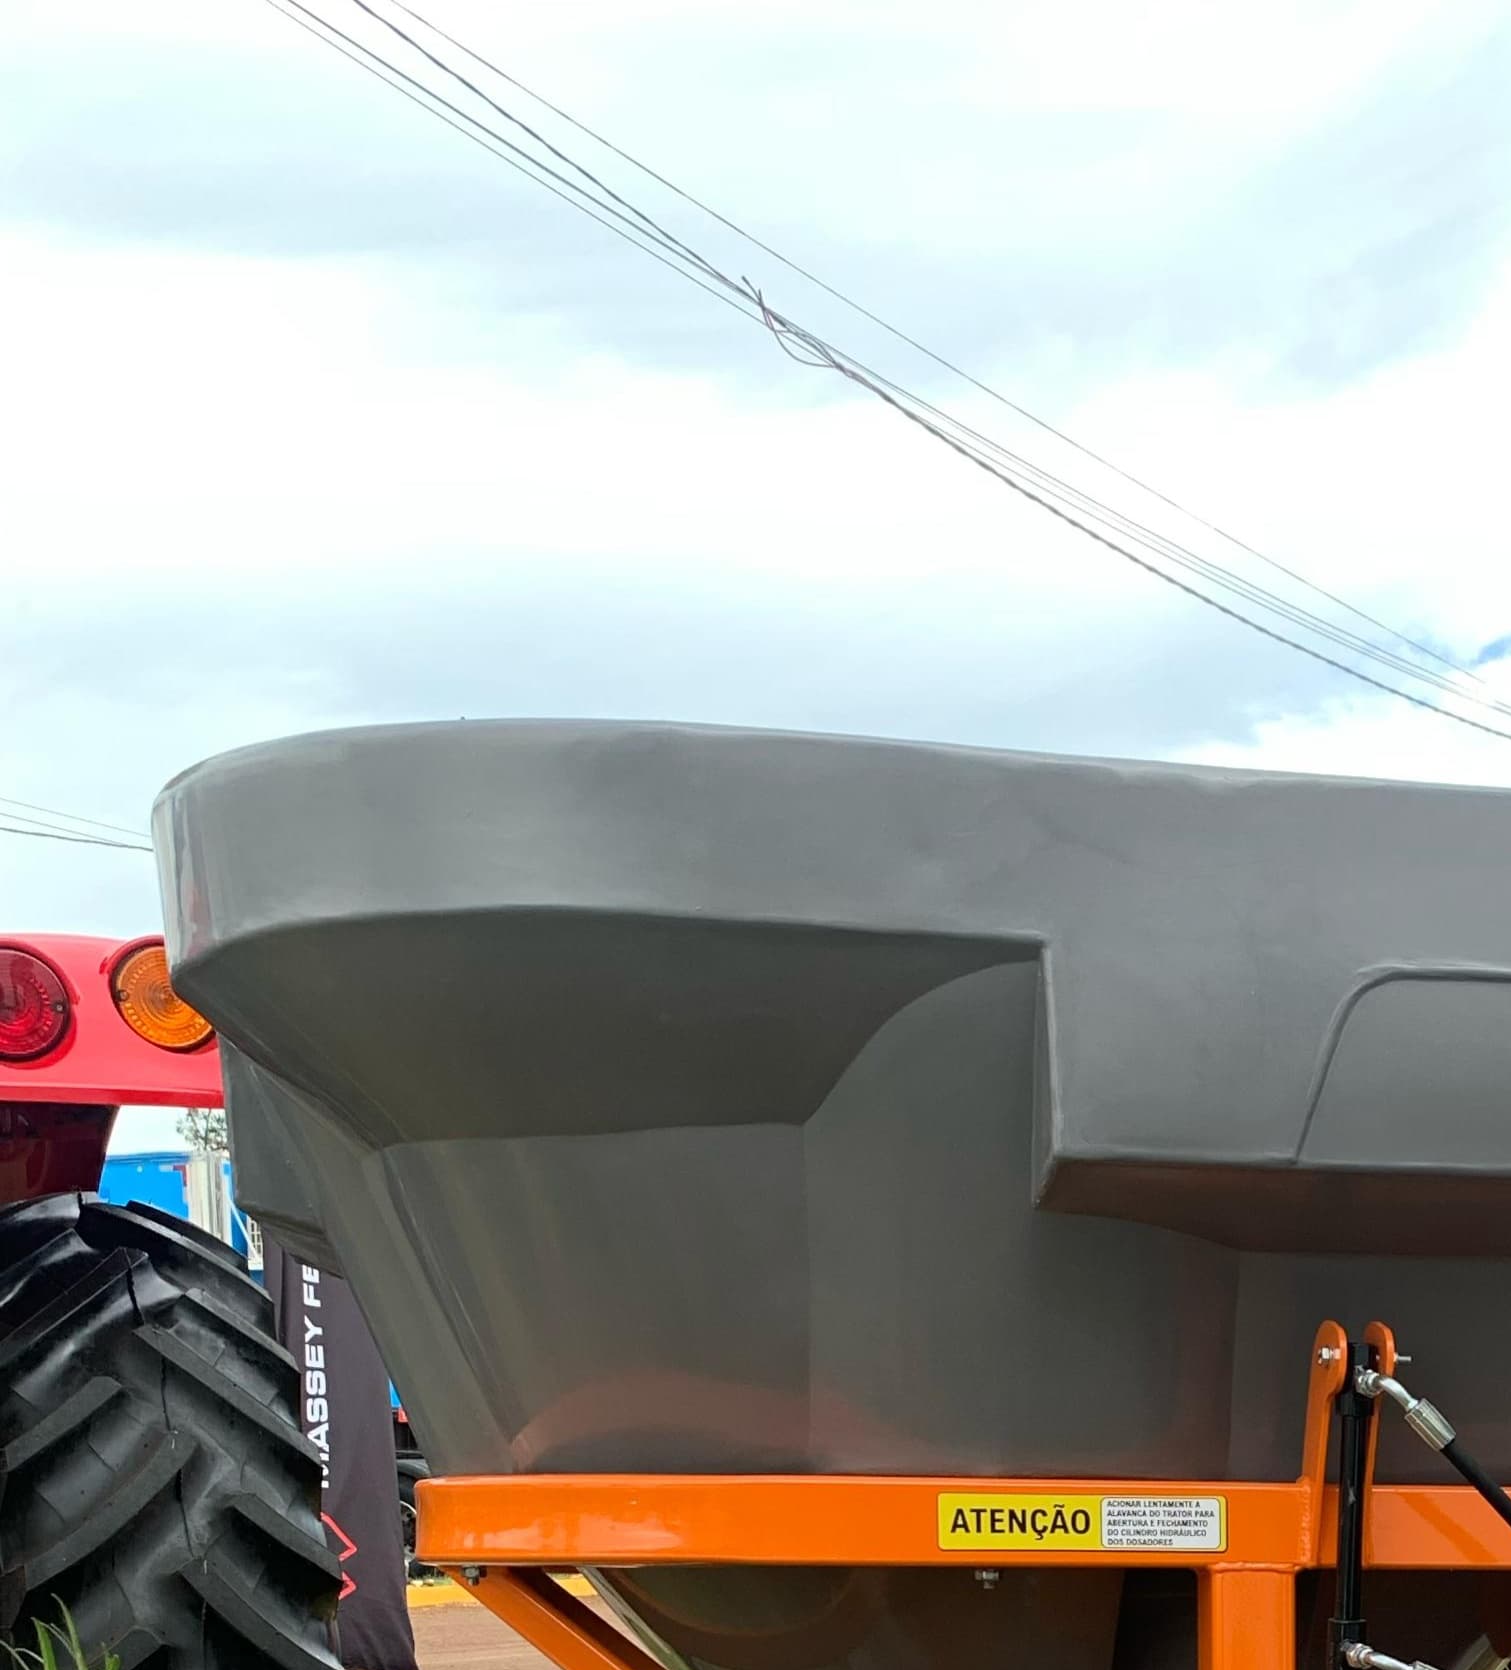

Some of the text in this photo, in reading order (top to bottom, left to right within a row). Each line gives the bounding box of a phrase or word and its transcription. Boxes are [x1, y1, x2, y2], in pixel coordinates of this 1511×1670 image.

[950, 1504, 1091, 1540] ATENÇÃO
[1107, 1519, 1149, 1527] ABERTURA
[1160, 1528, 1207, 1536] HIDRÁULICO
[1126, 1538, 1174, 1546] DOSADORES
